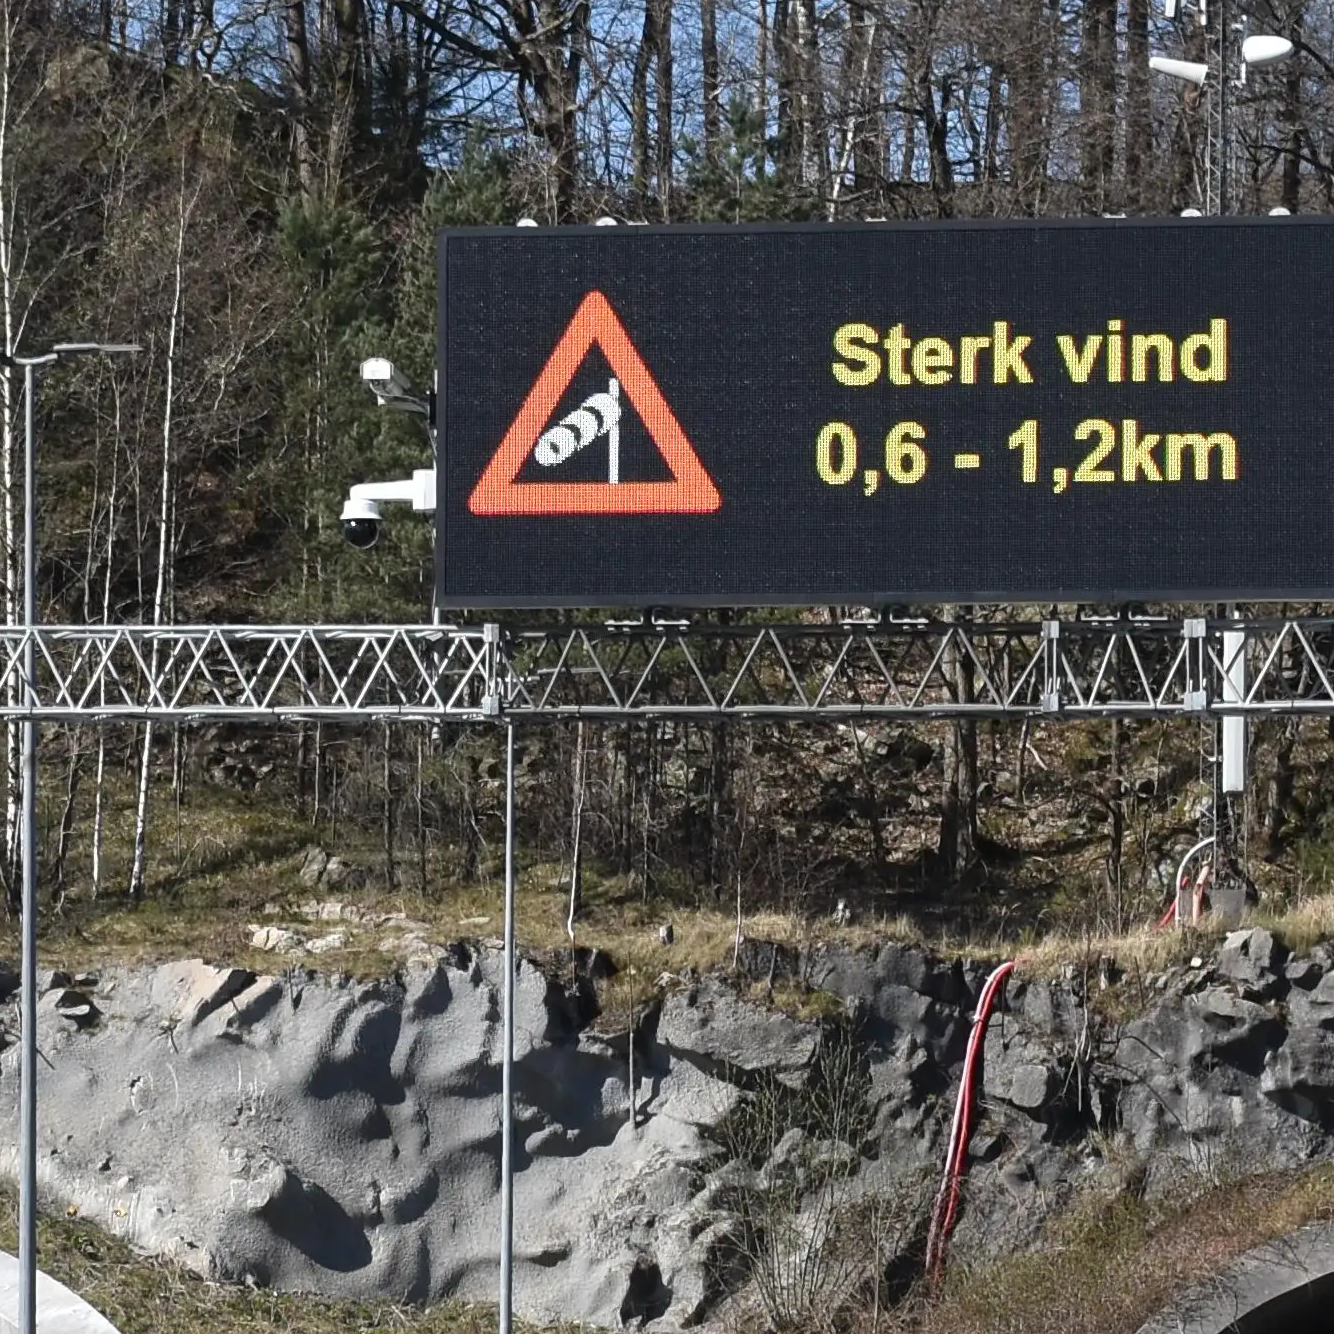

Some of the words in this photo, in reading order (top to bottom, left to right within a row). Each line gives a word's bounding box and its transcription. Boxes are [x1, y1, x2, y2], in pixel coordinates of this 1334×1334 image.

[832, 322, 1033, 386] Sterk
[1057, 319, 1227, 383] vind
[816, 421, 926, 497] 0,6
[954, 453, 980, 469] -
[1007, 418, 1238, 495] 1,2km
